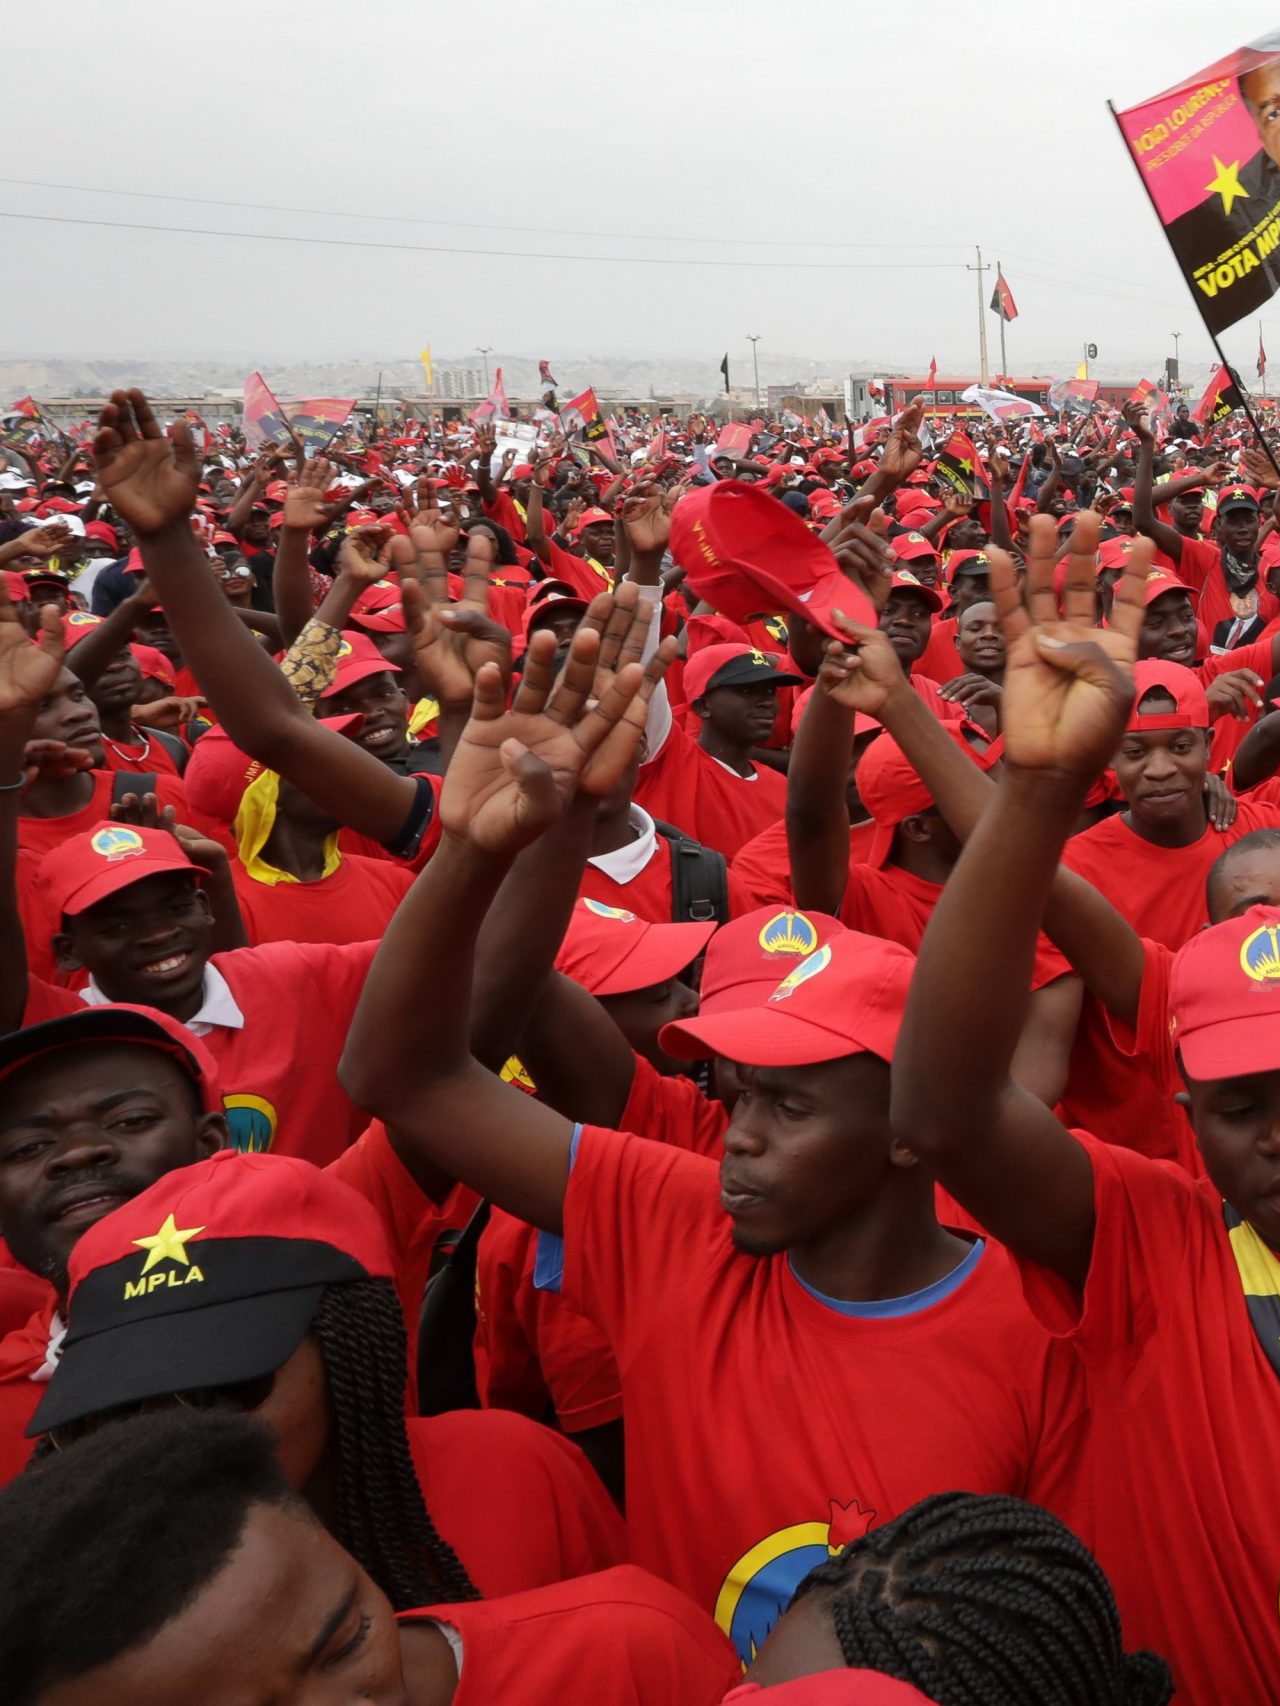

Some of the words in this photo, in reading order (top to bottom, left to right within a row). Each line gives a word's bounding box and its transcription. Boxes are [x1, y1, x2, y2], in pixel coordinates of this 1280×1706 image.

[1196, 248, 1261, 298] VOTA
[244, 760, 261, 783] JMP
[123, 1264, 205, 1301] MPLA
